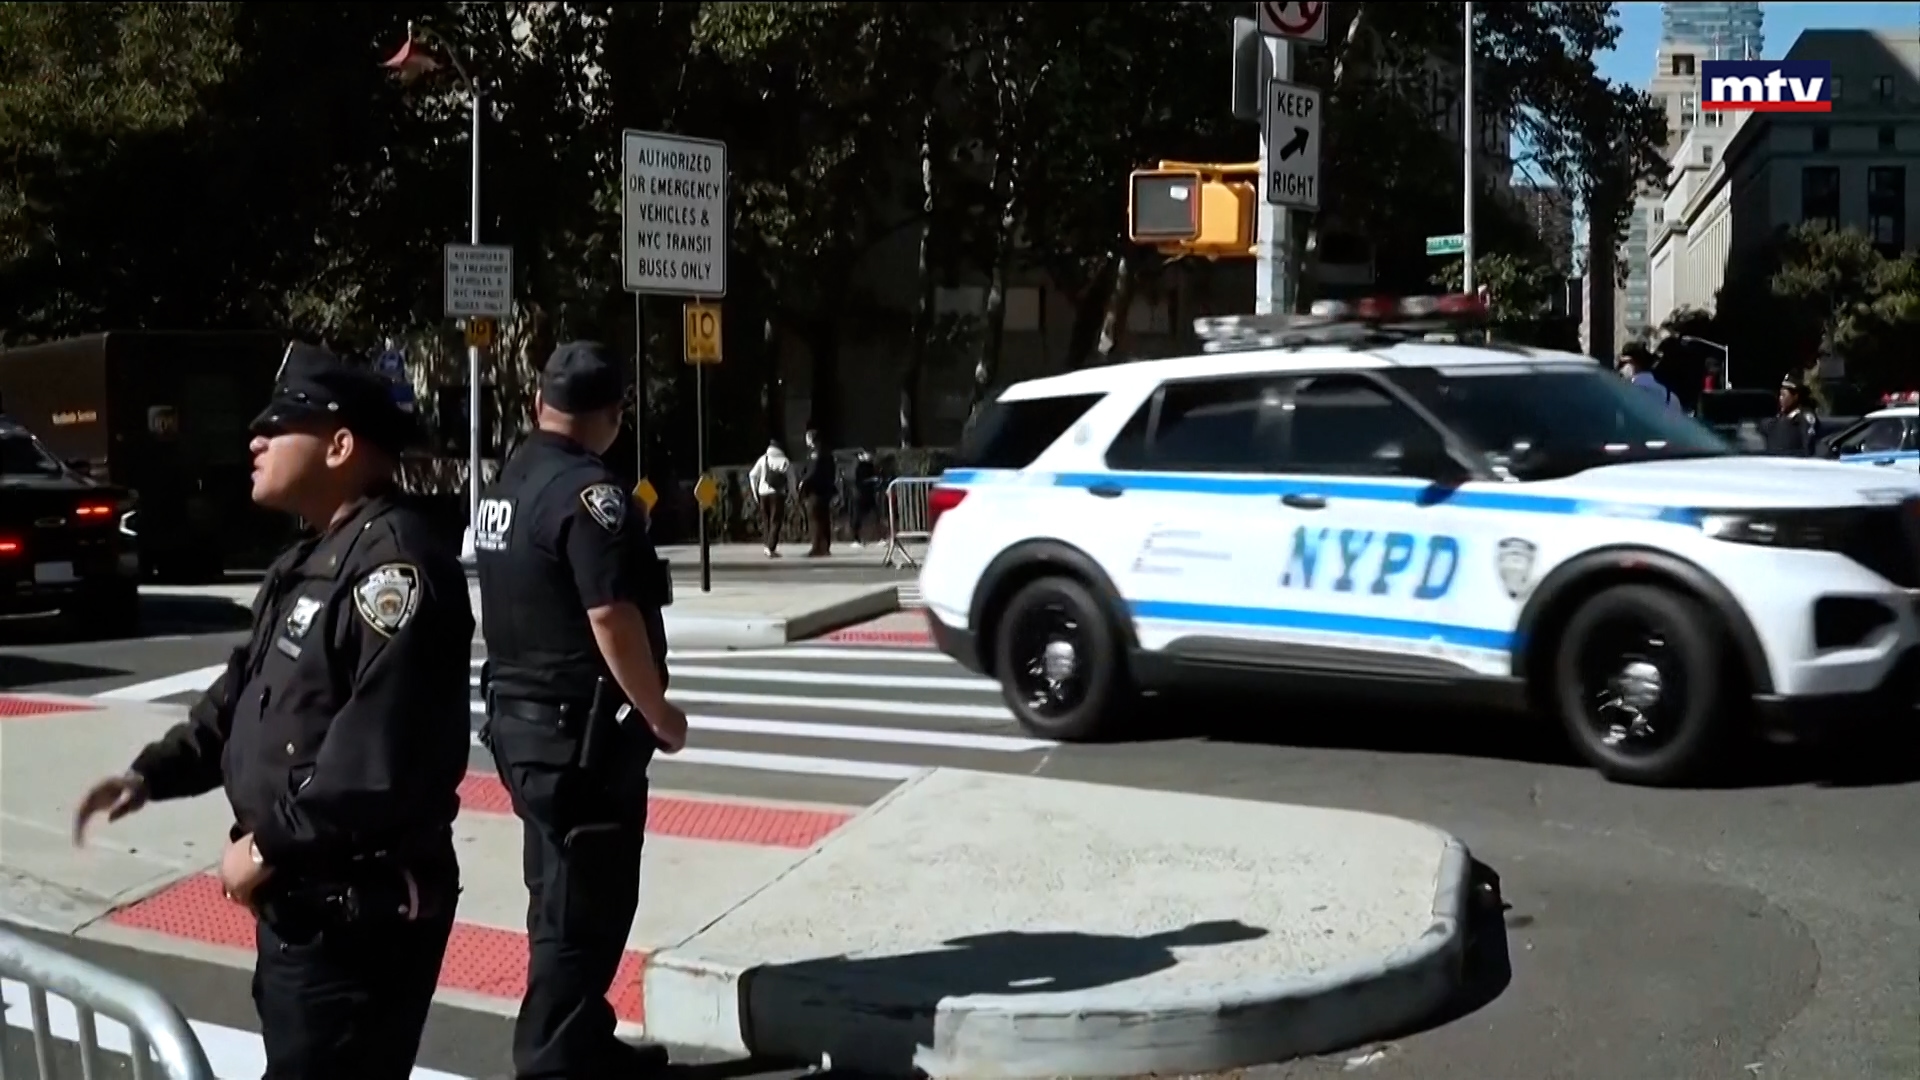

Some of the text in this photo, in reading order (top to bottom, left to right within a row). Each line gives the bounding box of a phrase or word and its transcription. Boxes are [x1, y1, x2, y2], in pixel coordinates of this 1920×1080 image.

[1277, 91, 1314, 118] KEEP
[638, 147, 711, 174] AUTHORIZED
[629, 174, 720, 200] OR EMERGENCY
[1272, 170, 1314, 198] RIGHT
[640, 203, 710, 227] VEHICLES &
[638, 230, 712, 253] NYC TRANSIT
[639, 257, 712, 280] BUSES ONLY
[690, 312, 715, 339] 10
[1281, 525, 1459, 600] NYPD
